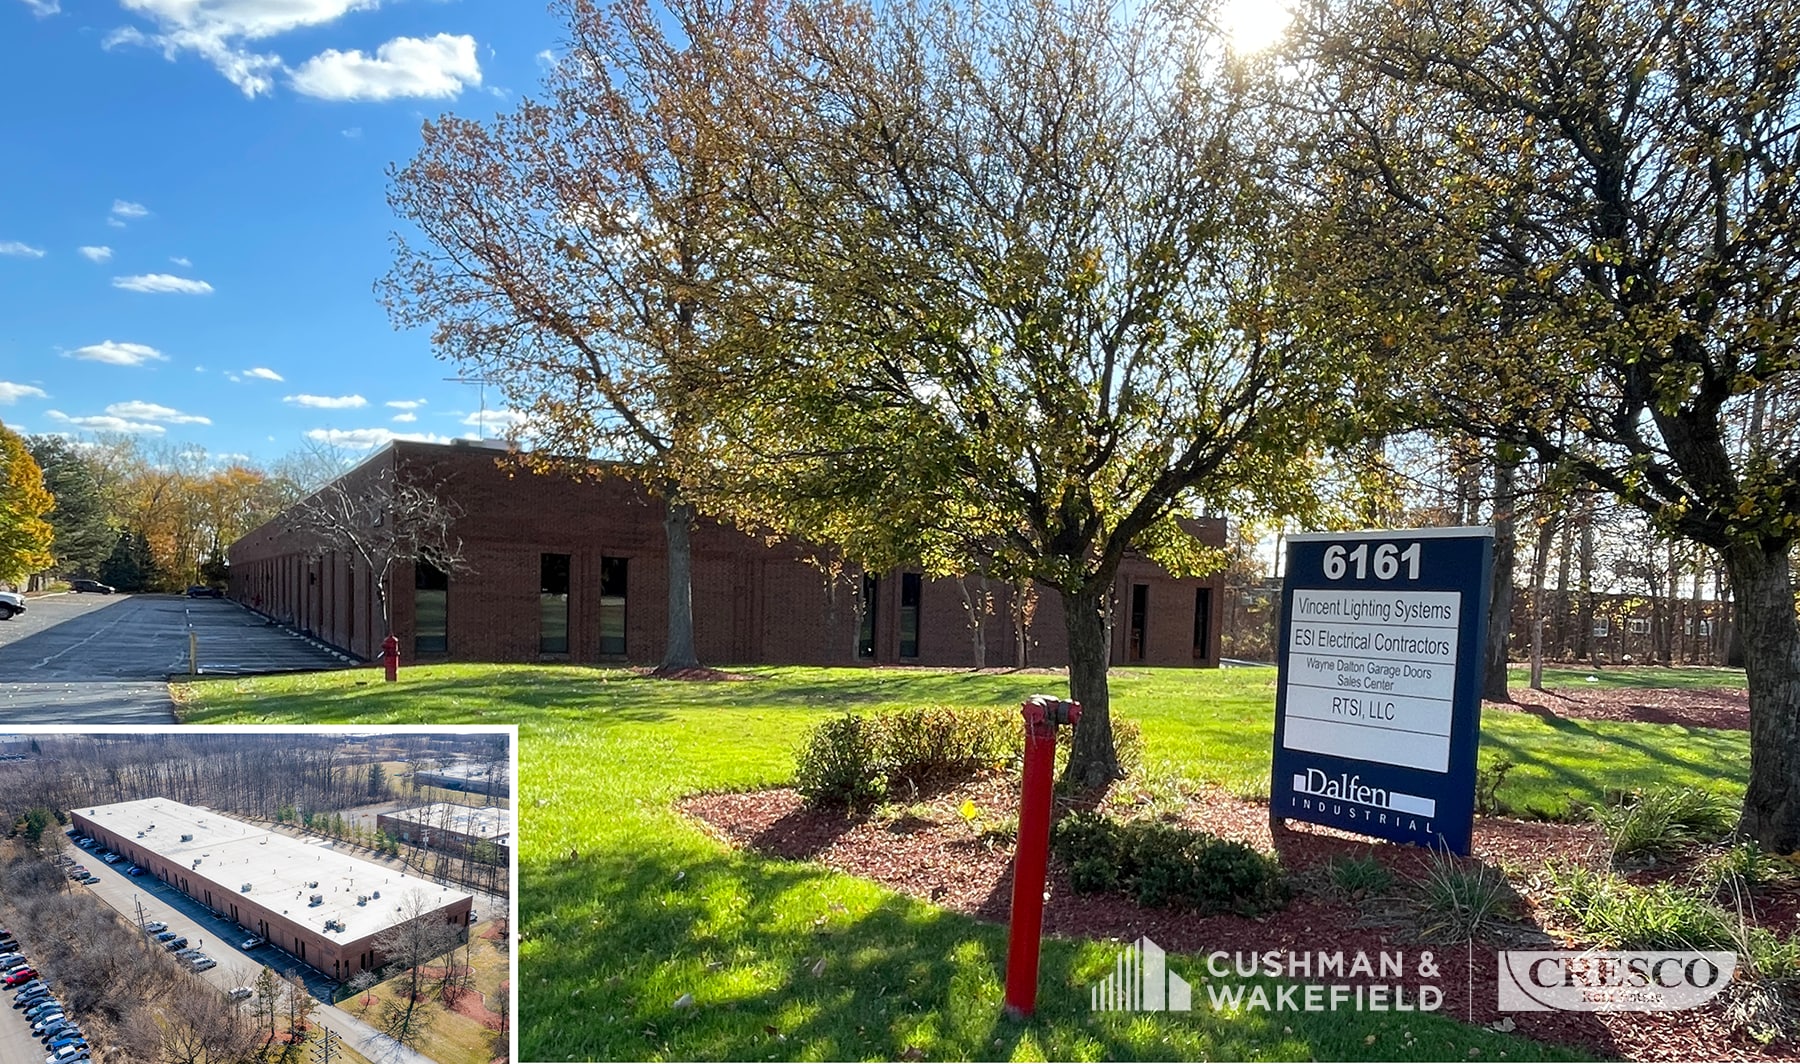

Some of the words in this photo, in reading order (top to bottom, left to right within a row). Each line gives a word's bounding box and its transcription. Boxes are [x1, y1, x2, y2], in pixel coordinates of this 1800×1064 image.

[1323, 542, 1421, 580] 6161
[1299, 597, 1341, 616] Vincent
[1343, 600, 1391, 621] Lighting
[1394, 600, 1452, 622] Systems
[1295, 628, 1315, 647] ESI
[1318, 629, 1371, 651] Electrical
[1374, 632, 1450, 656] Contractors
[1306, 656, 1335, 672] Wayne
[1337, 659, 1365, 674] Dalton
[1367, 662, 1401, 679] Garage
[1403, 664, 1432, 680] Doors
[1337, 674, 1361, 689] Sales
[1364, 676, 1394, 692] Center
[1332, 696, 1365, 720] RTSI,
[1369, 701, 1395, 721] LLC
[1306, 767, 1388, 808] Dalfen
[1292, 797, 1433, 834] INDUSTRIAL
